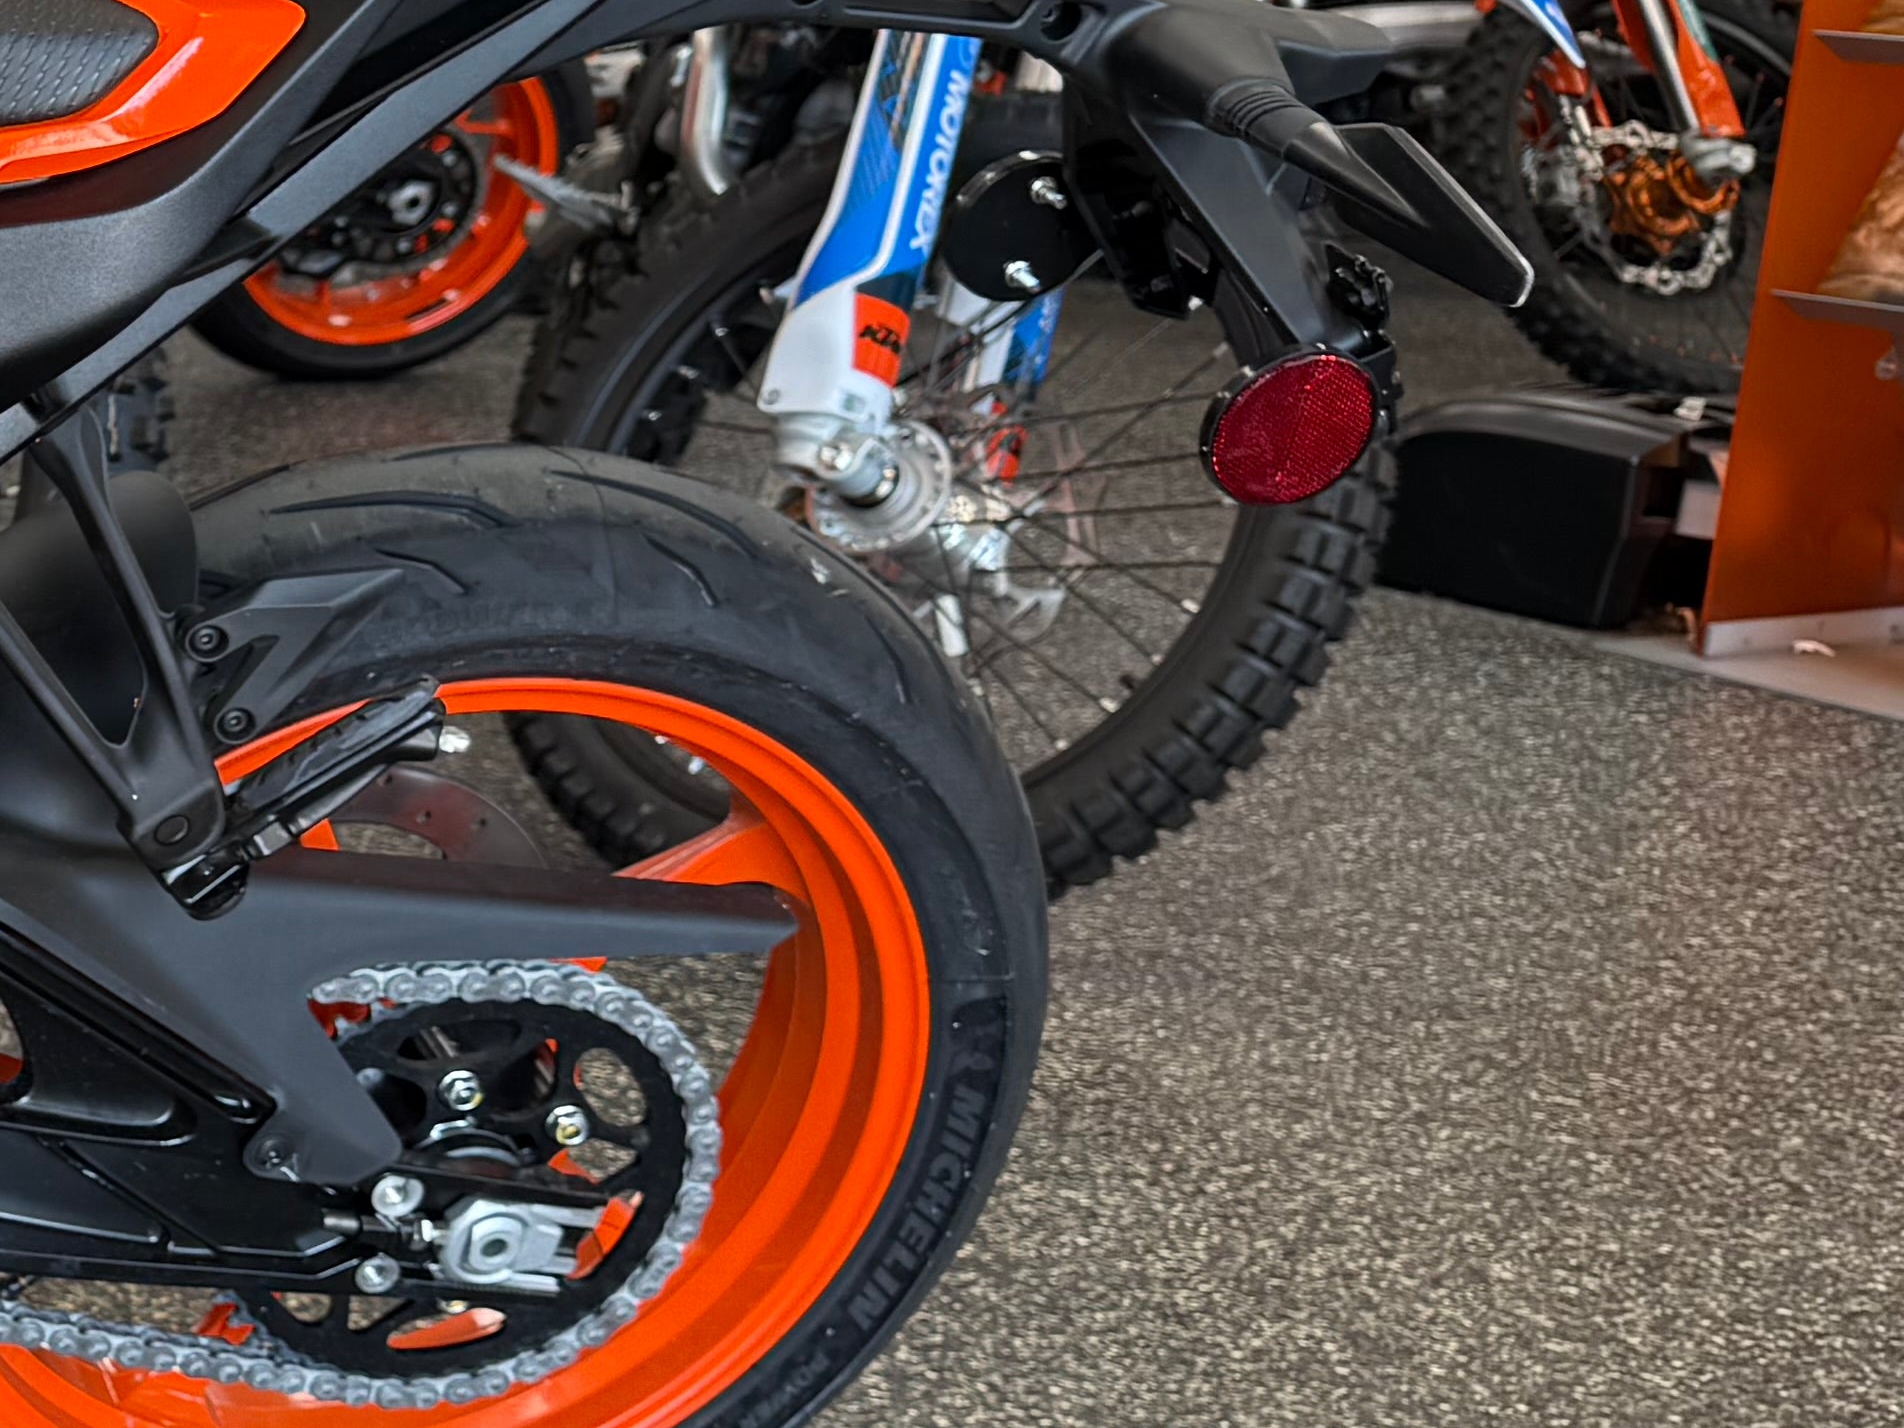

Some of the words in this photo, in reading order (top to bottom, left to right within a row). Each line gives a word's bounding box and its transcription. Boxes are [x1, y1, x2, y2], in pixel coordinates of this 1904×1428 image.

[909, 68, 967, 252] MOTOREX
[860, 324, 903, 356] KTM
[848, 1084, 986, 1331] MICHELIN
